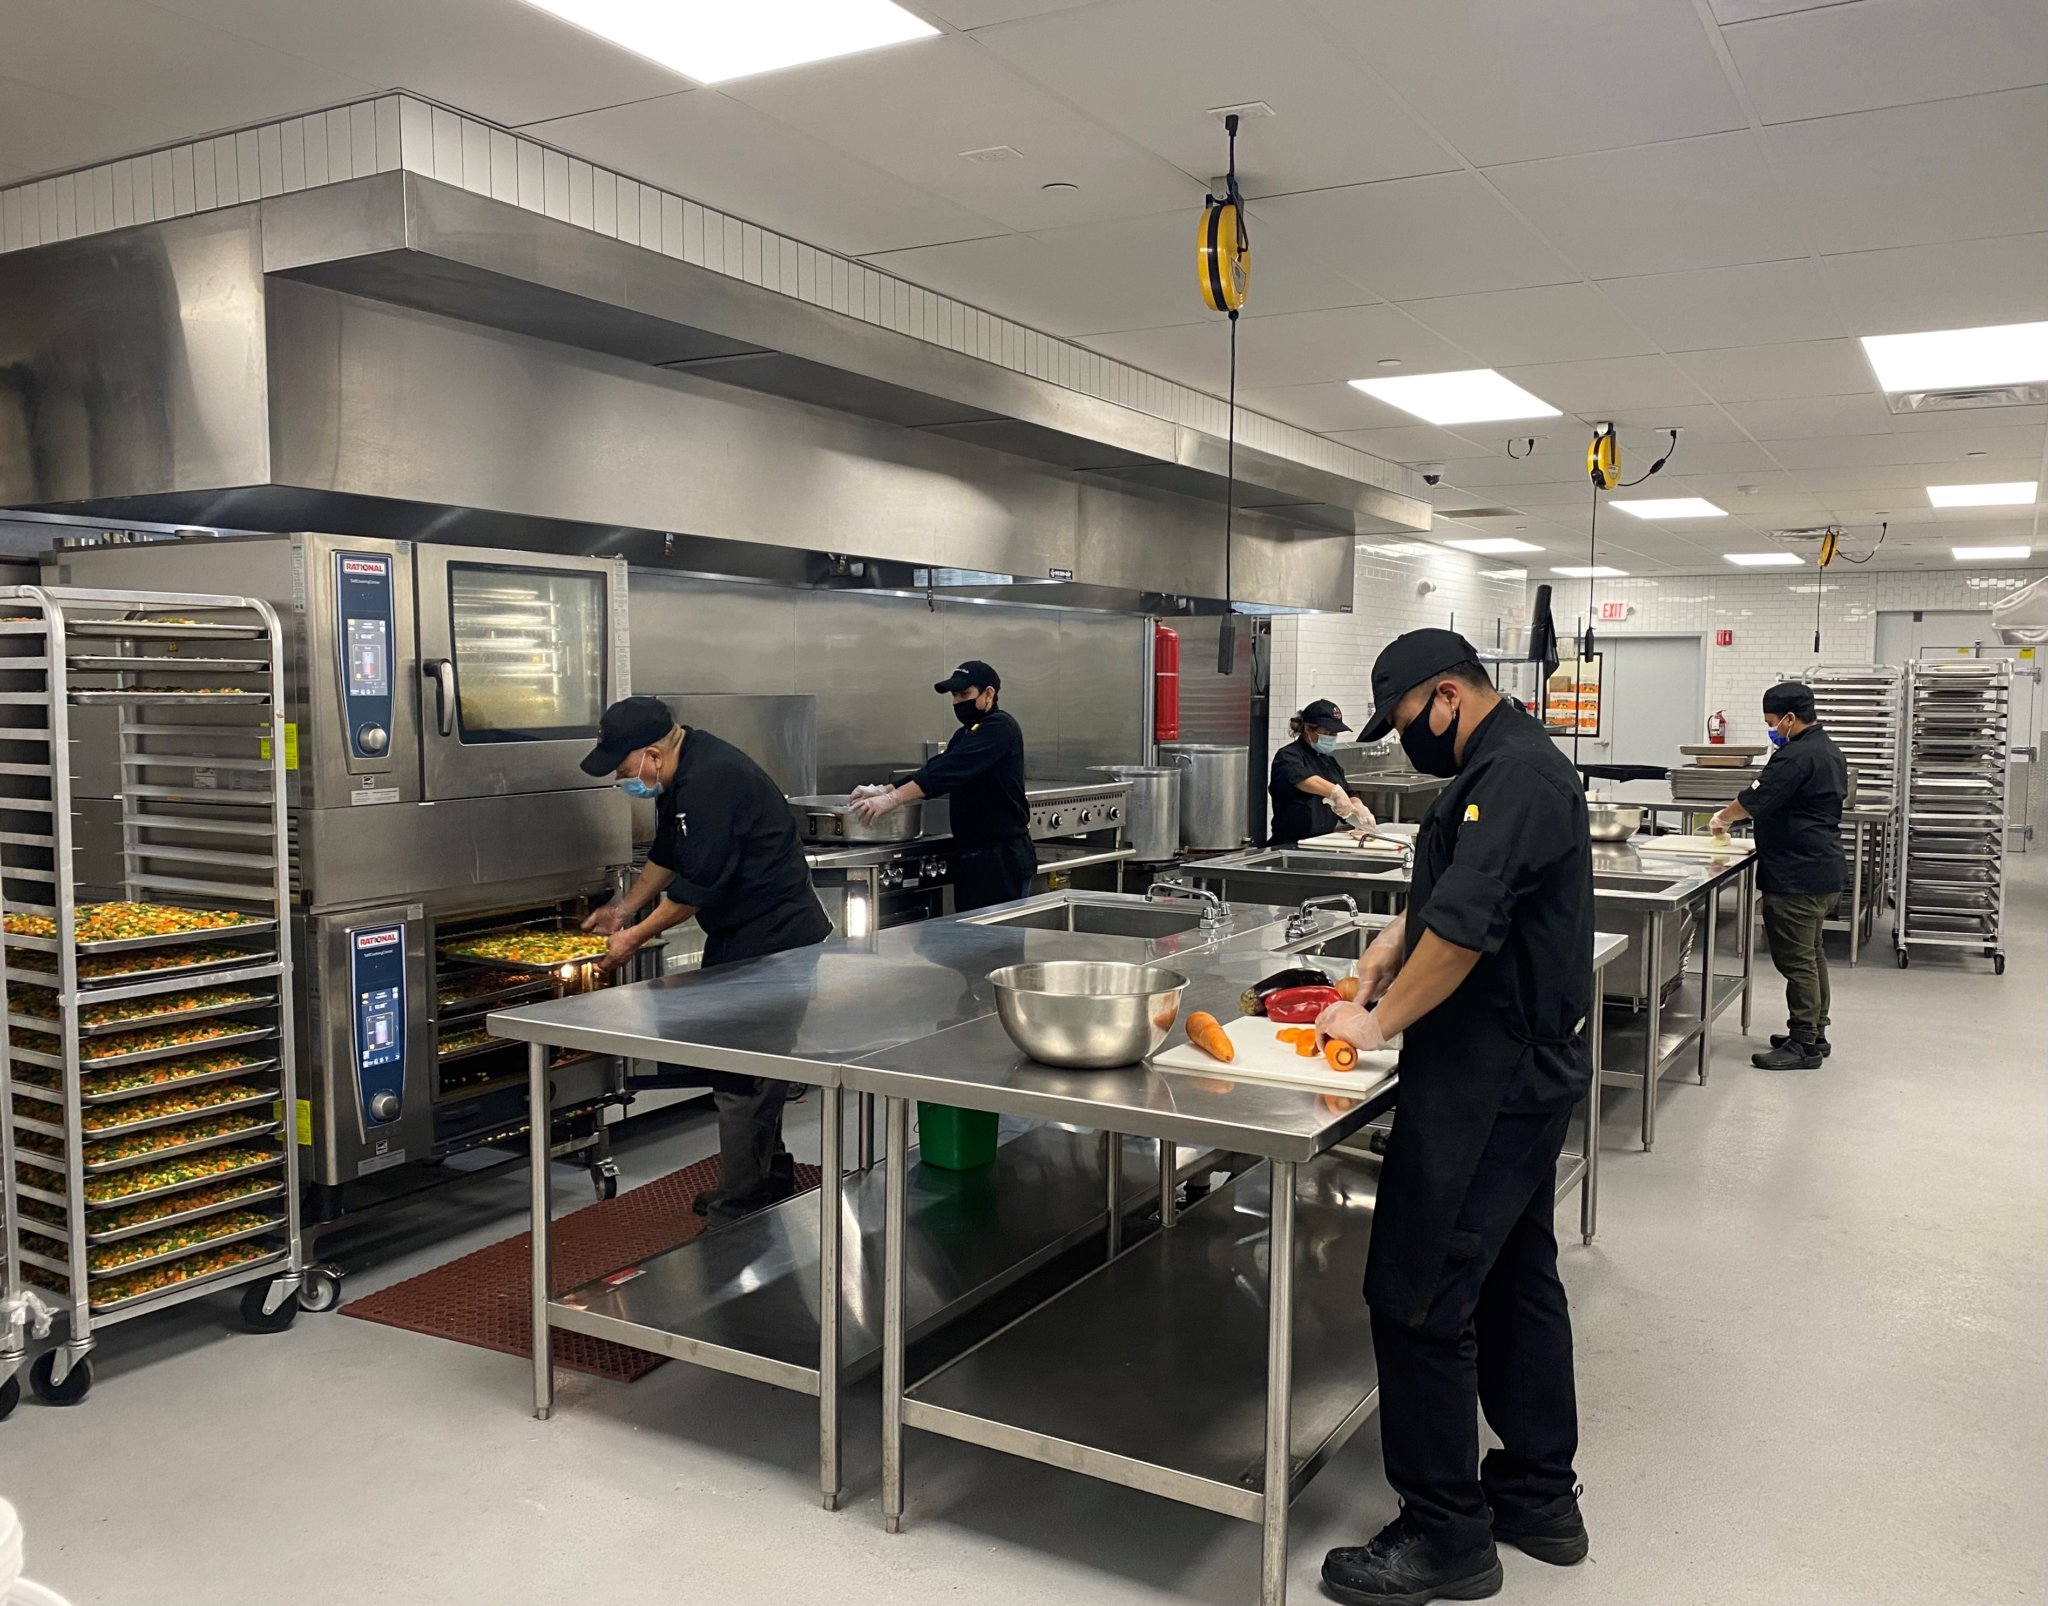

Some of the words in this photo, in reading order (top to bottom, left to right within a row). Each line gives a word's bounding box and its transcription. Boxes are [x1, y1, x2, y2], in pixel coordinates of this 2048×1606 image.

[346, 563, 383, 572] RATIONAL
[1603, 603, 1624, 618] EXIT
[360, 934, 396, 946] RATIONAL
